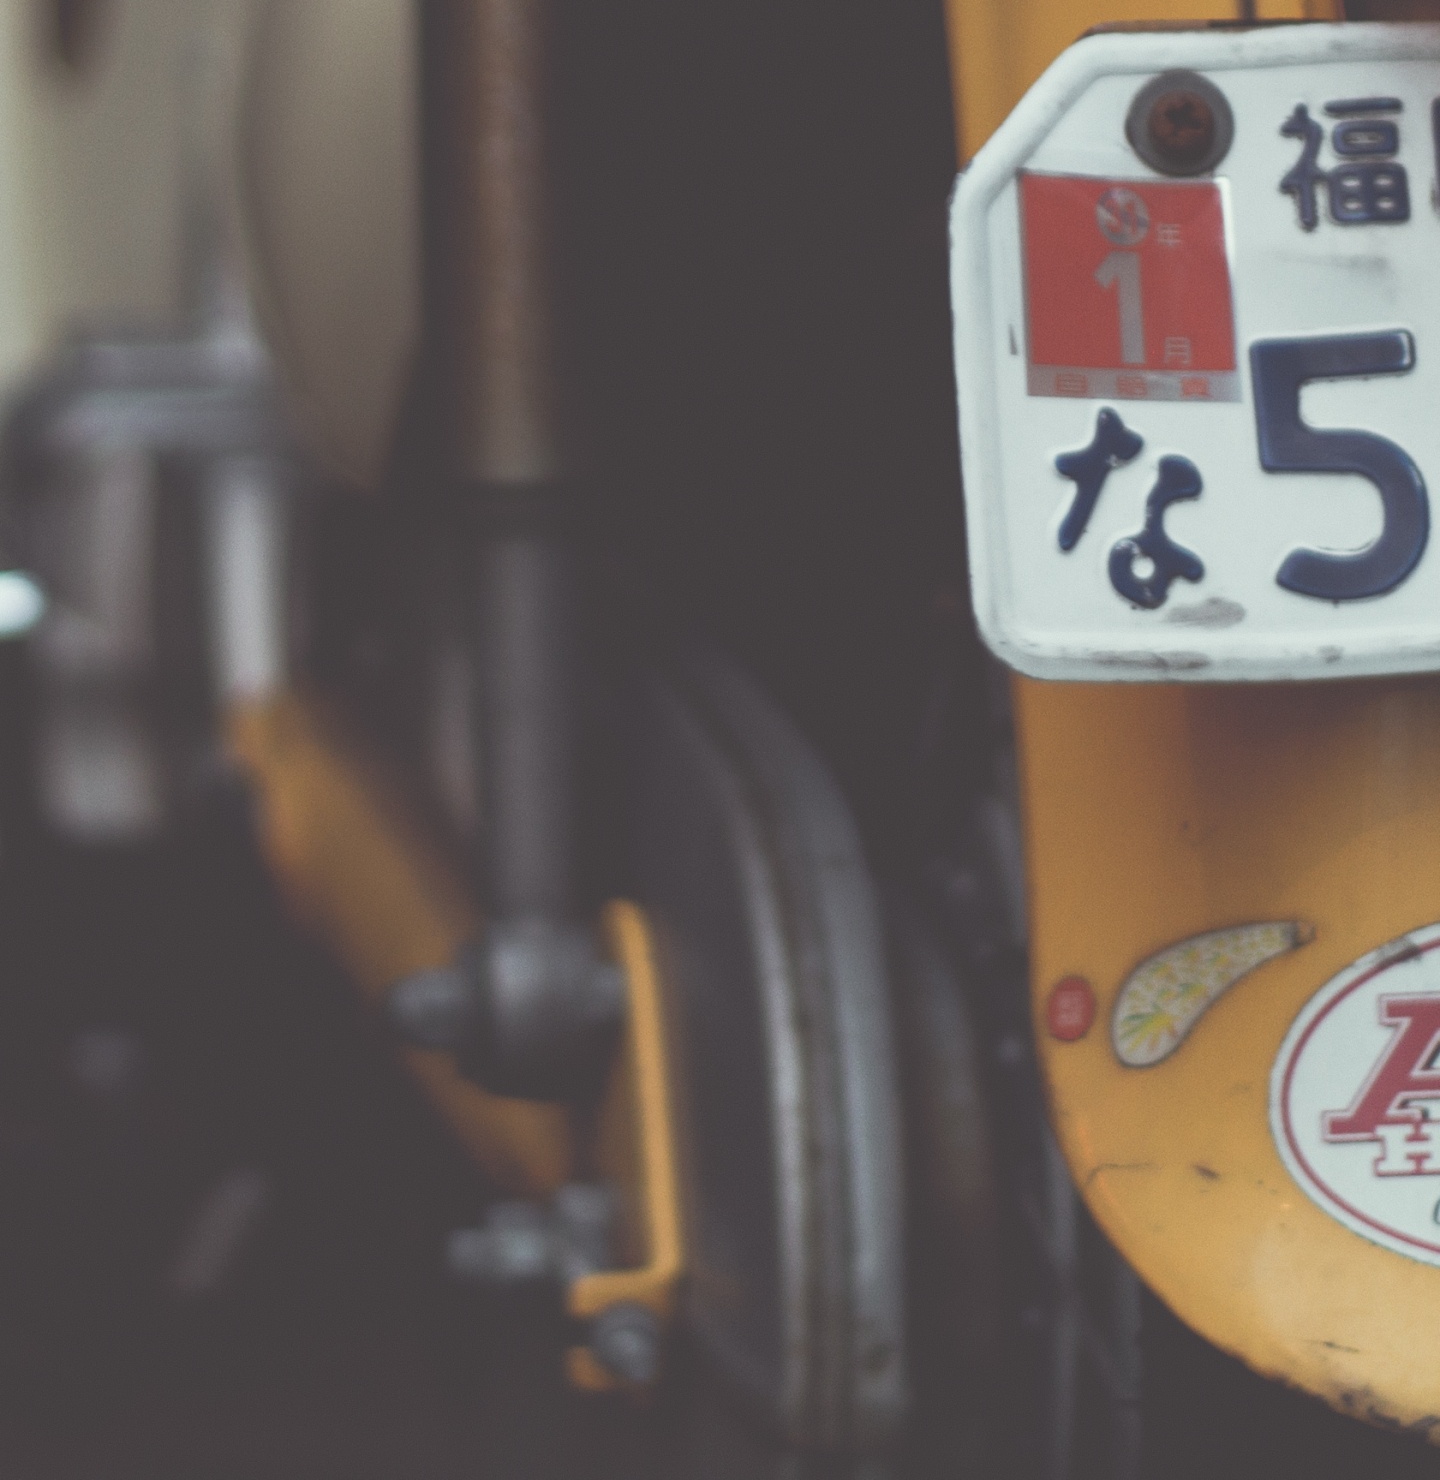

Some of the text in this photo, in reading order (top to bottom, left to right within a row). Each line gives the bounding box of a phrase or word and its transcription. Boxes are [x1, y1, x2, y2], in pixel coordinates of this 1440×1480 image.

[1279, 96, 1440, 234] 福
[1055, 328, 1430, 609] な 5
